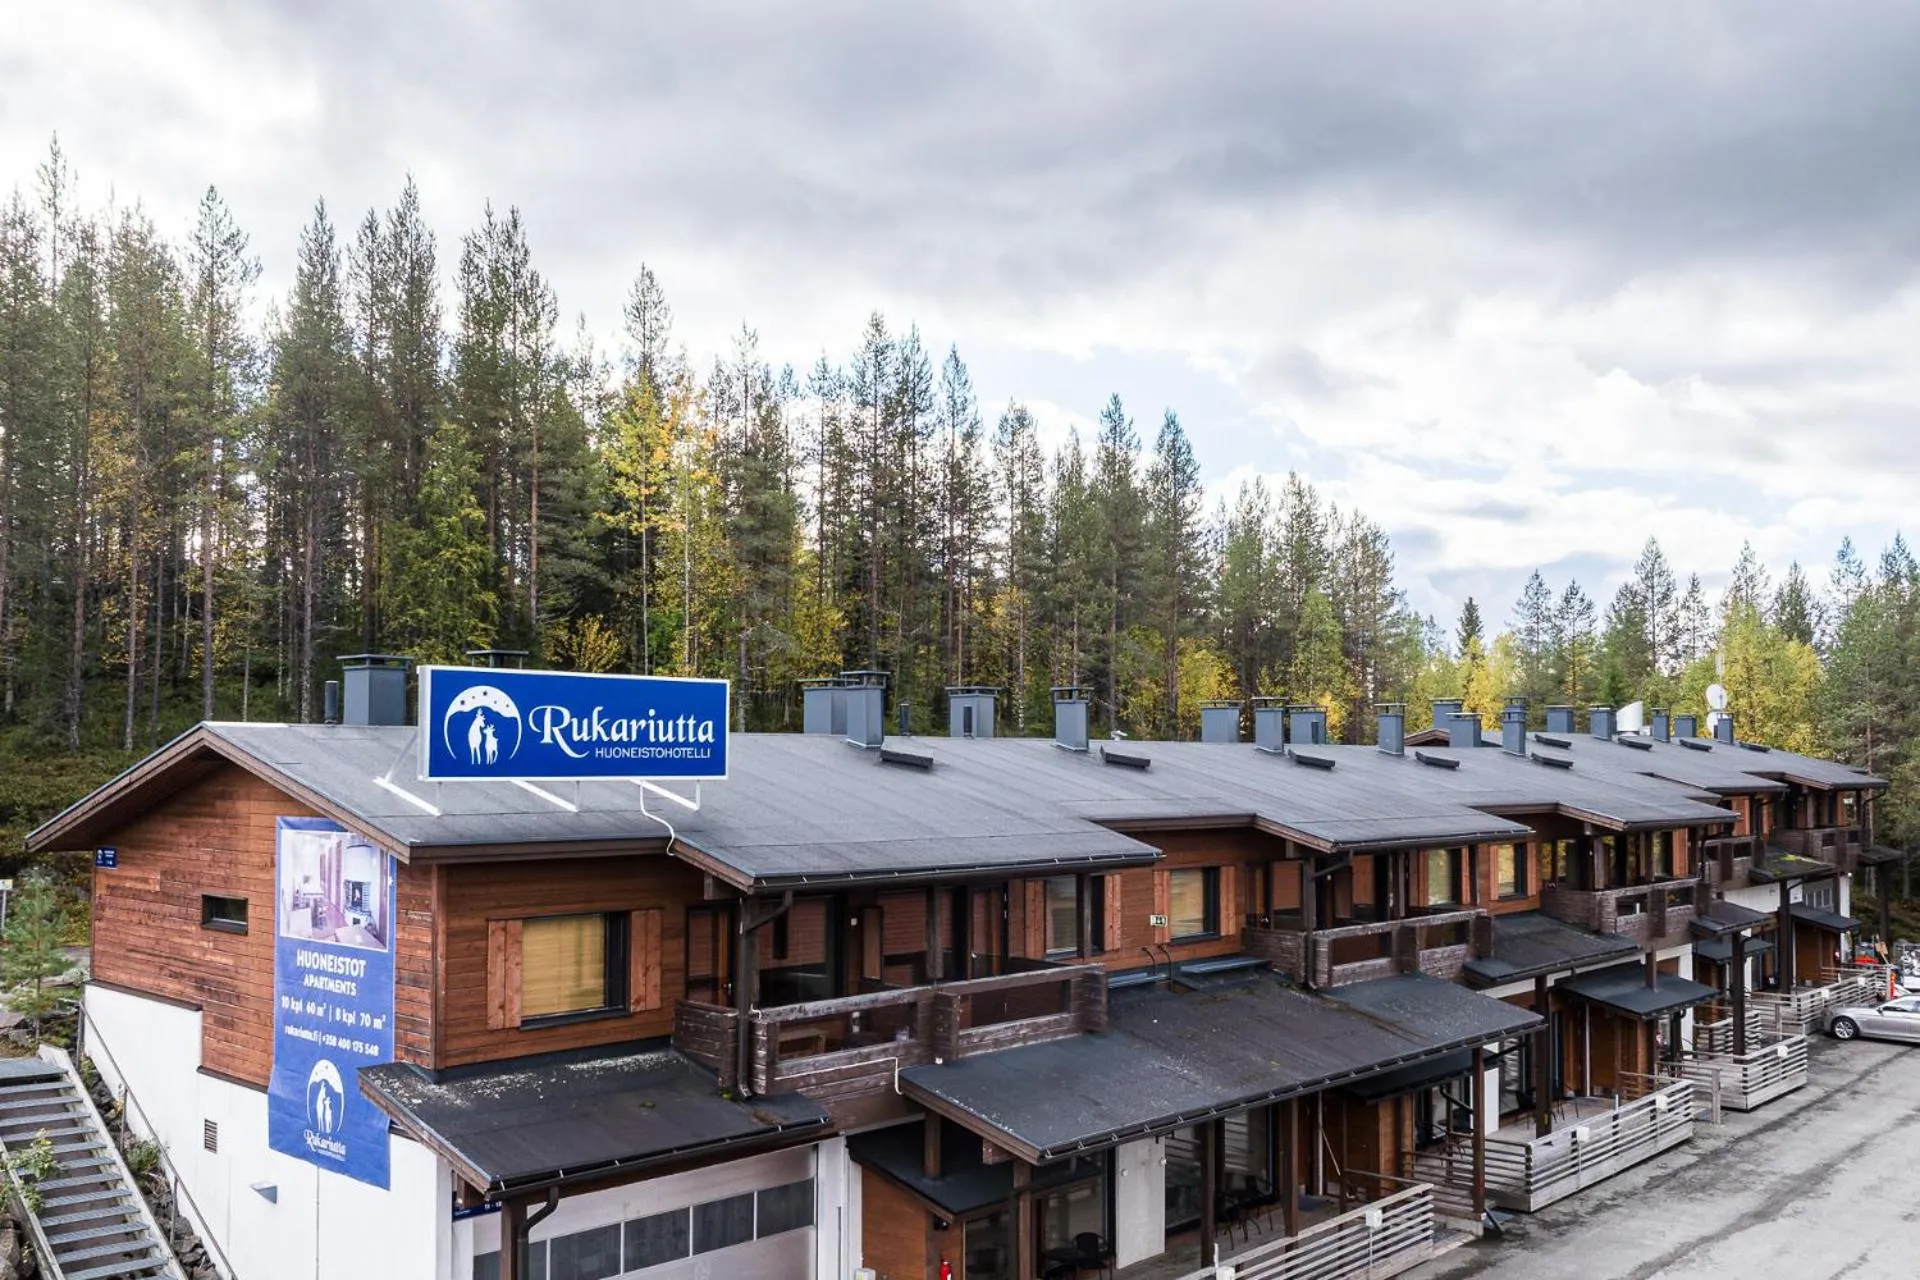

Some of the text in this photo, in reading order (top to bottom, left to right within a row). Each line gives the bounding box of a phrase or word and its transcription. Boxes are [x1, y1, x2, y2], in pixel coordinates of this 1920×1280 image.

[529, 705, 715, 758] Rukariutta
[595, 747, 711, 759] HUONEISTOHOTELLI
[296, 948, 367, 978] HUONEISTOT
[303, 974, 357, 997] APARTMENTS
[342, 1008, 356, 1027] kpl
[360, 1012, 371, 1027] 70
